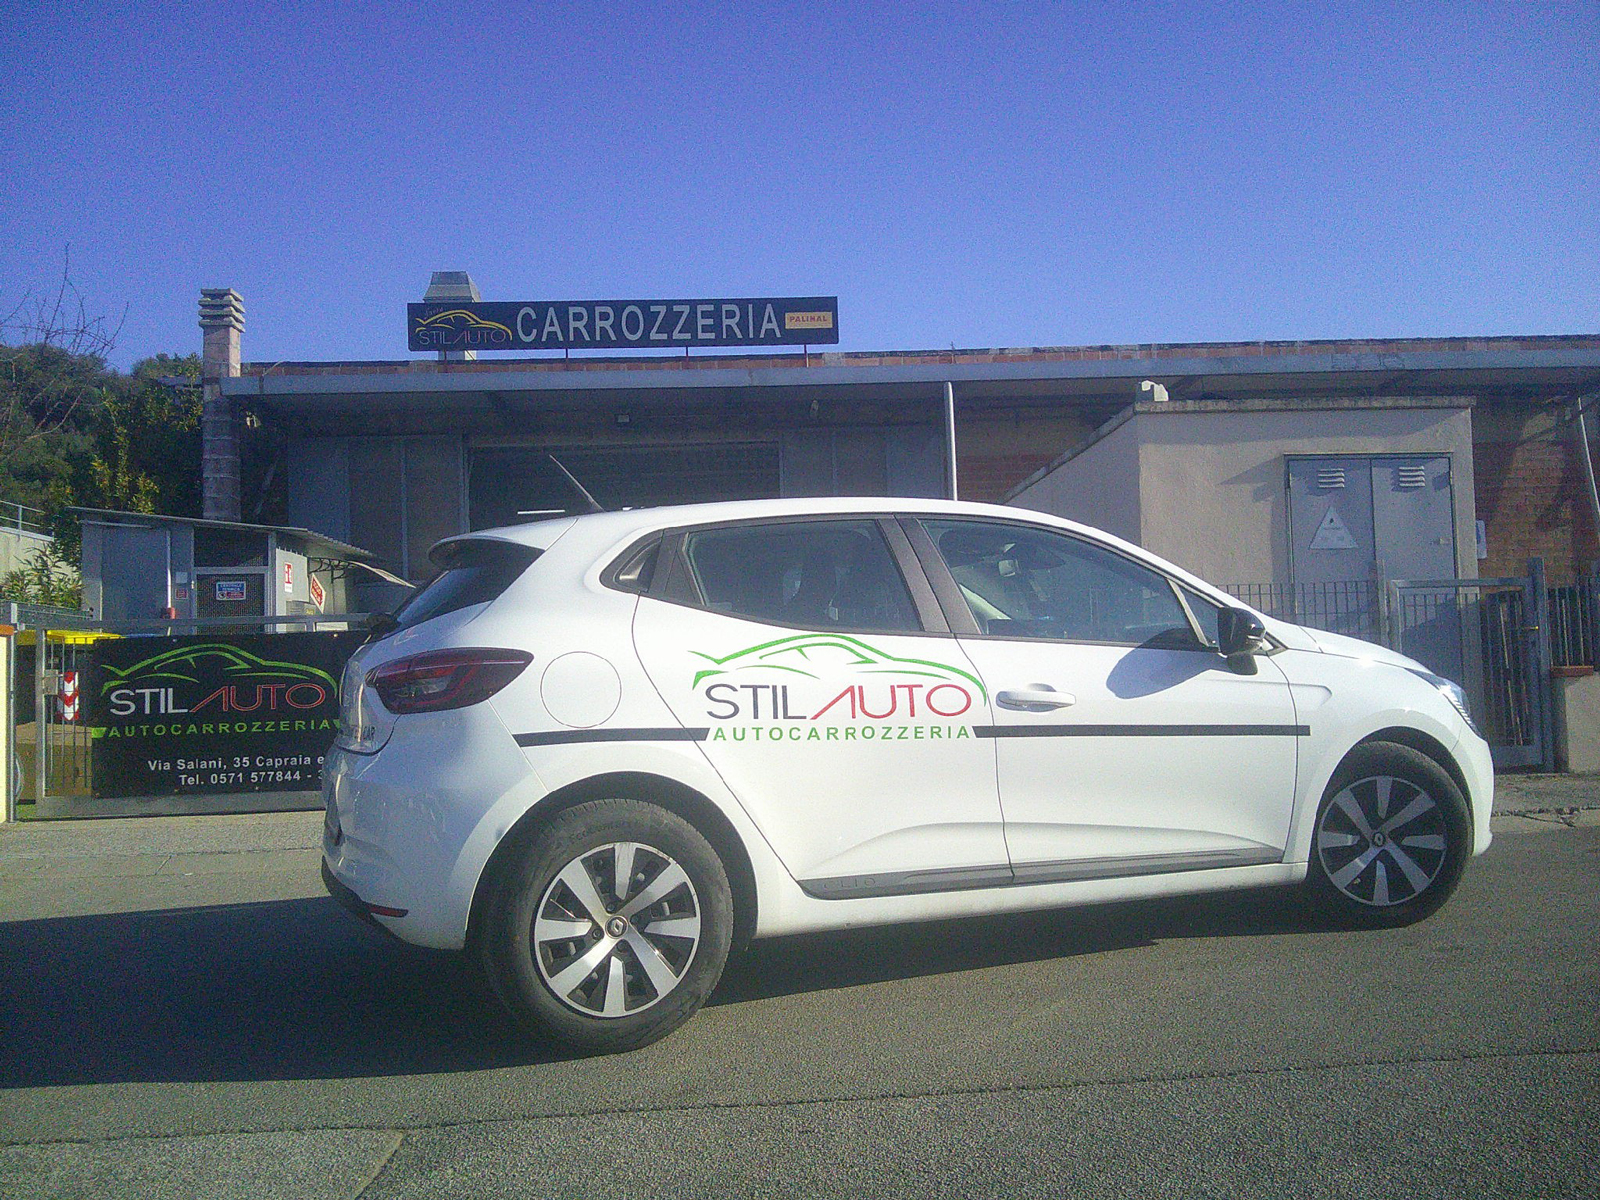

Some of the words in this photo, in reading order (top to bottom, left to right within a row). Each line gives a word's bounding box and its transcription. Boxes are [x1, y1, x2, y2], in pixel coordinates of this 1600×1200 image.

[516, 303, 782, 342] CARROZZERIA
[108, 719, 331, 738] AUTOCARROZZERIA
[713, 725, 970, 741] AUTOCARROZZERIA
[148, 760, 171, 771] Via
[177, 757, 227, 771] Salani,
[233, 756, 250, 768] 35
[256, 754, 309, 769] Capraia
[179, 774, 204, 786] Tel.
[210, 772, 243, 784] 0571
[250, 771, 301, 783] 577844
